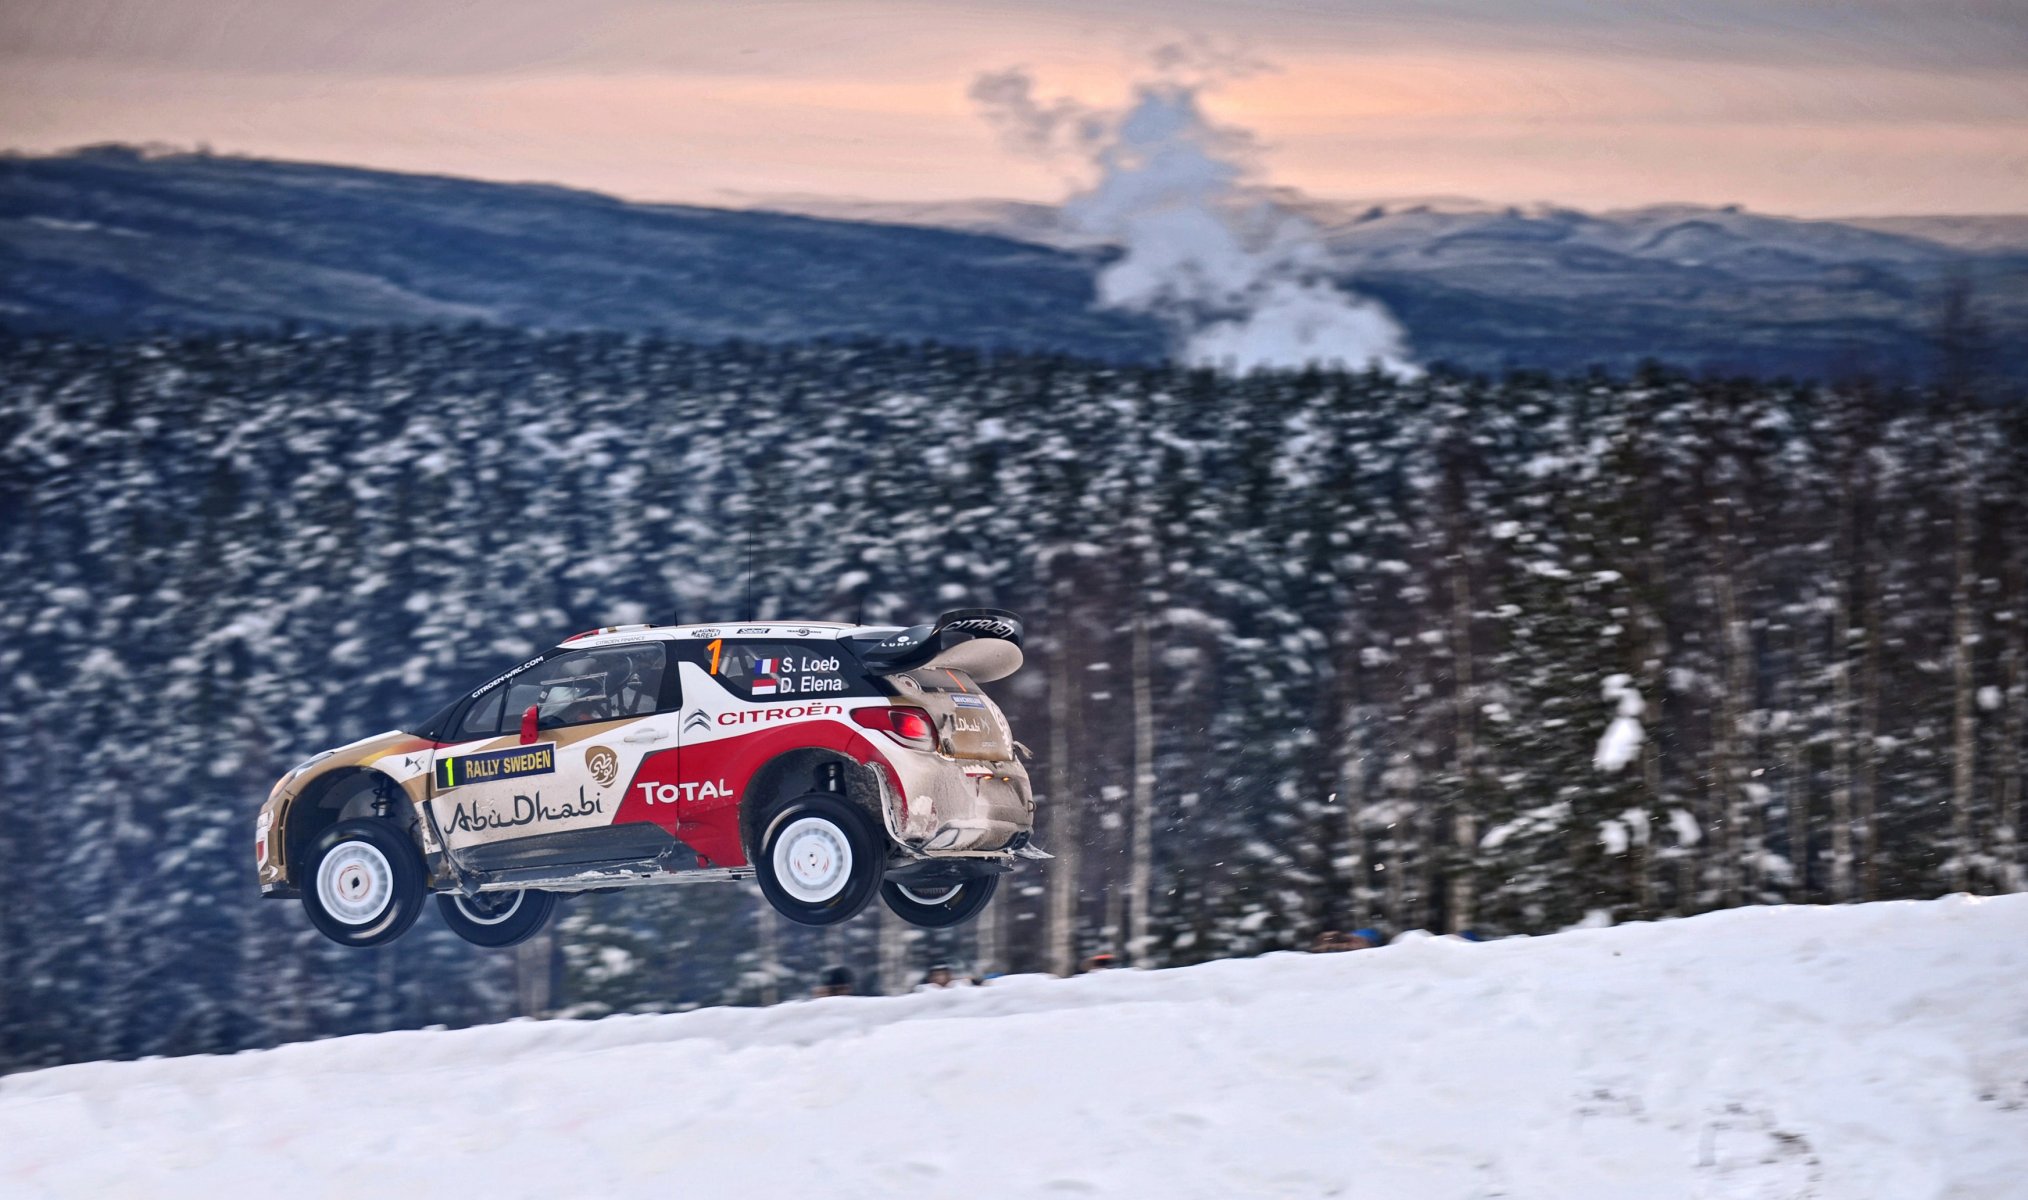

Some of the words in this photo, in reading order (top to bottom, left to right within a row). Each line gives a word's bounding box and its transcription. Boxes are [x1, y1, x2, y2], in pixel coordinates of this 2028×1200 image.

[706, 638, 723, 675] 1
[781, 657, 797, 673] S.
[801, 656, 840, 672] Loeb
[780, 677, 796, 694] D.
[800, 676, 843, 692] Elena
[445, 757, 455, 787] 1
[465, 759, 500, 779] RALLY
[503, 750, 551, 774] SWEDEN
[637, 779, 734, 805] TOTAL
